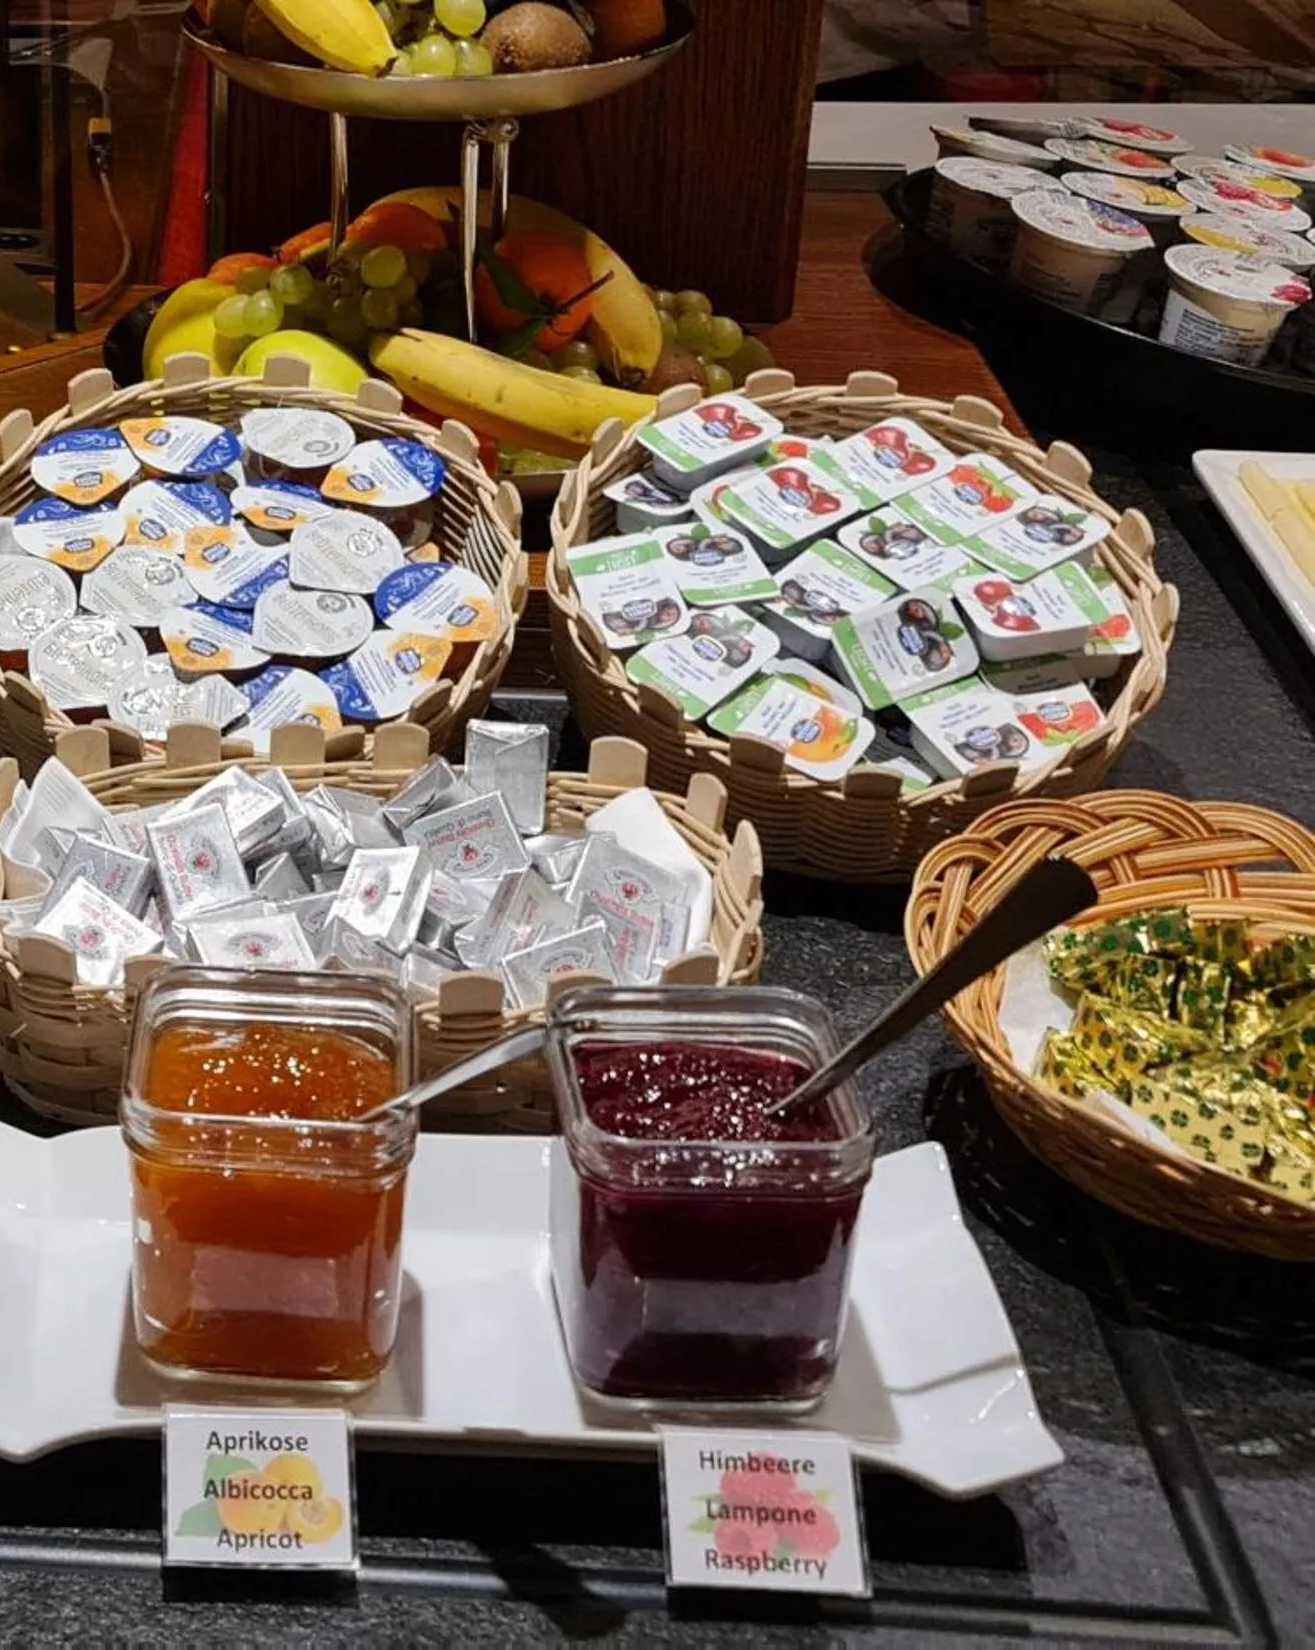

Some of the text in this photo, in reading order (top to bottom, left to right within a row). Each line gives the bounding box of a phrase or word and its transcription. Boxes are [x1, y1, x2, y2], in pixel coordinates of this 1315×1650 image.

[206, 1430, 309, 1455] Aprikose
[699, 1450, 816, 1475] Himbeere
[204, 1478, 313, 1500] Albicocca
[705, 1498, 817, 1525] Lampone
[217, 1528, 303, 1552] Apricot
[705, 1549, 827, 1580] Raspberry
